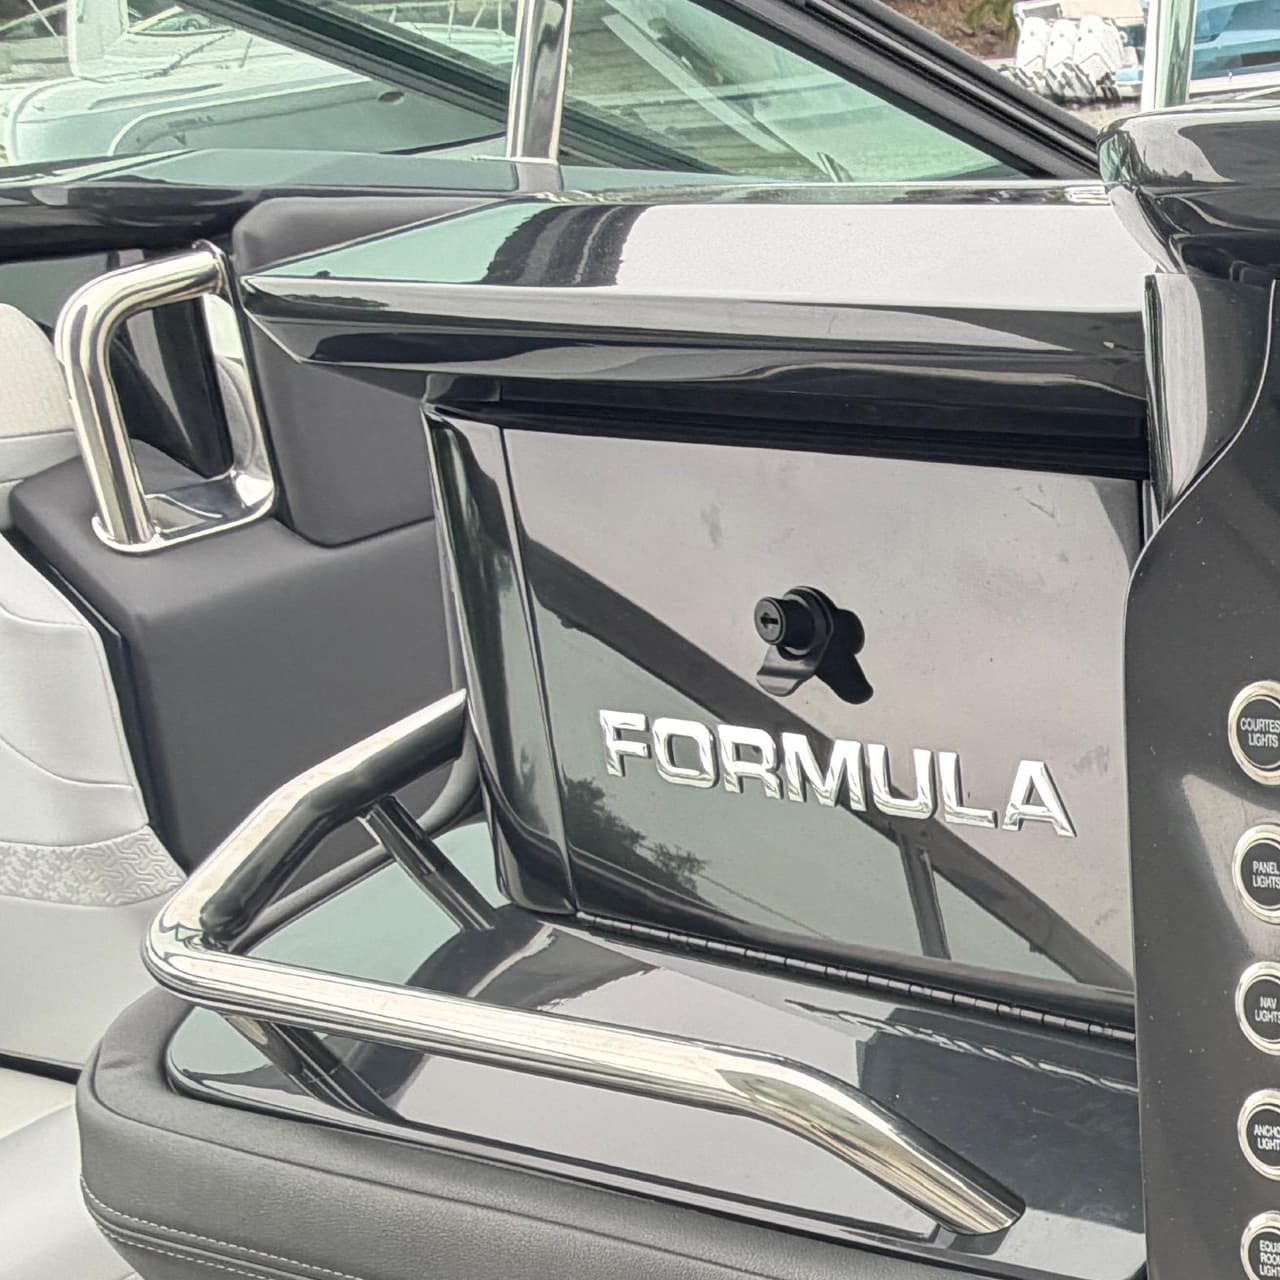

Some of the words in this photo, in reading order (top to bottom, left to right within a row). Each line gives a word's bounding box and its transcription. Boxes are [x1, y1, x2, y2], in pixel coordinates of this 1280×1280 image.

[1248, 733, 1280, 748] LIGHTS
[599, 709, 1077, 838] FORMULA
[1252, 860, 1280, 876] PANEL
[1259, 996, 1278, 1010] NAV
